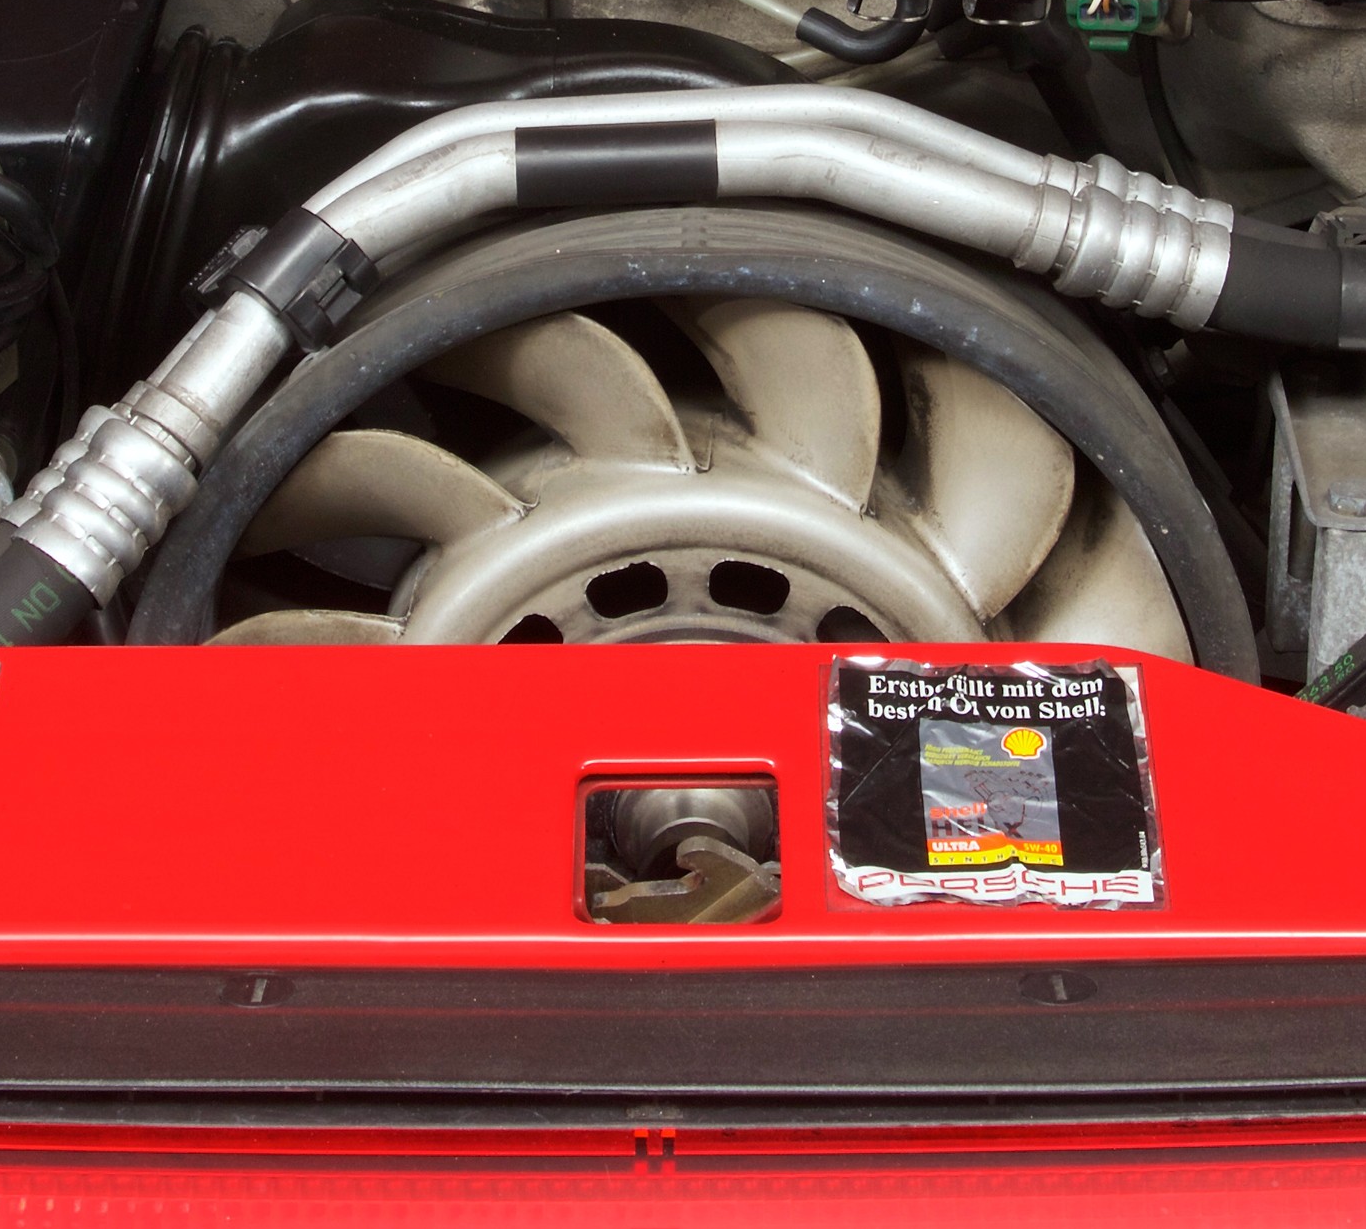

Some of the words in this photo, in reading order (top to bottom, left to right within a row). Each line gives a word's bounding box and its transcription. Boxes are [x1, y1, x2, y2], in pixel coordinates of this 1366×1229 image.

[1002, 680, 1045, 698] mit
[1051, 677, 1104, 697] dem
[950, 692, 979, 716] Öl
[986, 704, 1031, 719] von
[1038, 696, 1107, 720] Shell:
[931, 840, 981, 852] ULTRA
[1022, 842, 1058, 853] 5W-40
